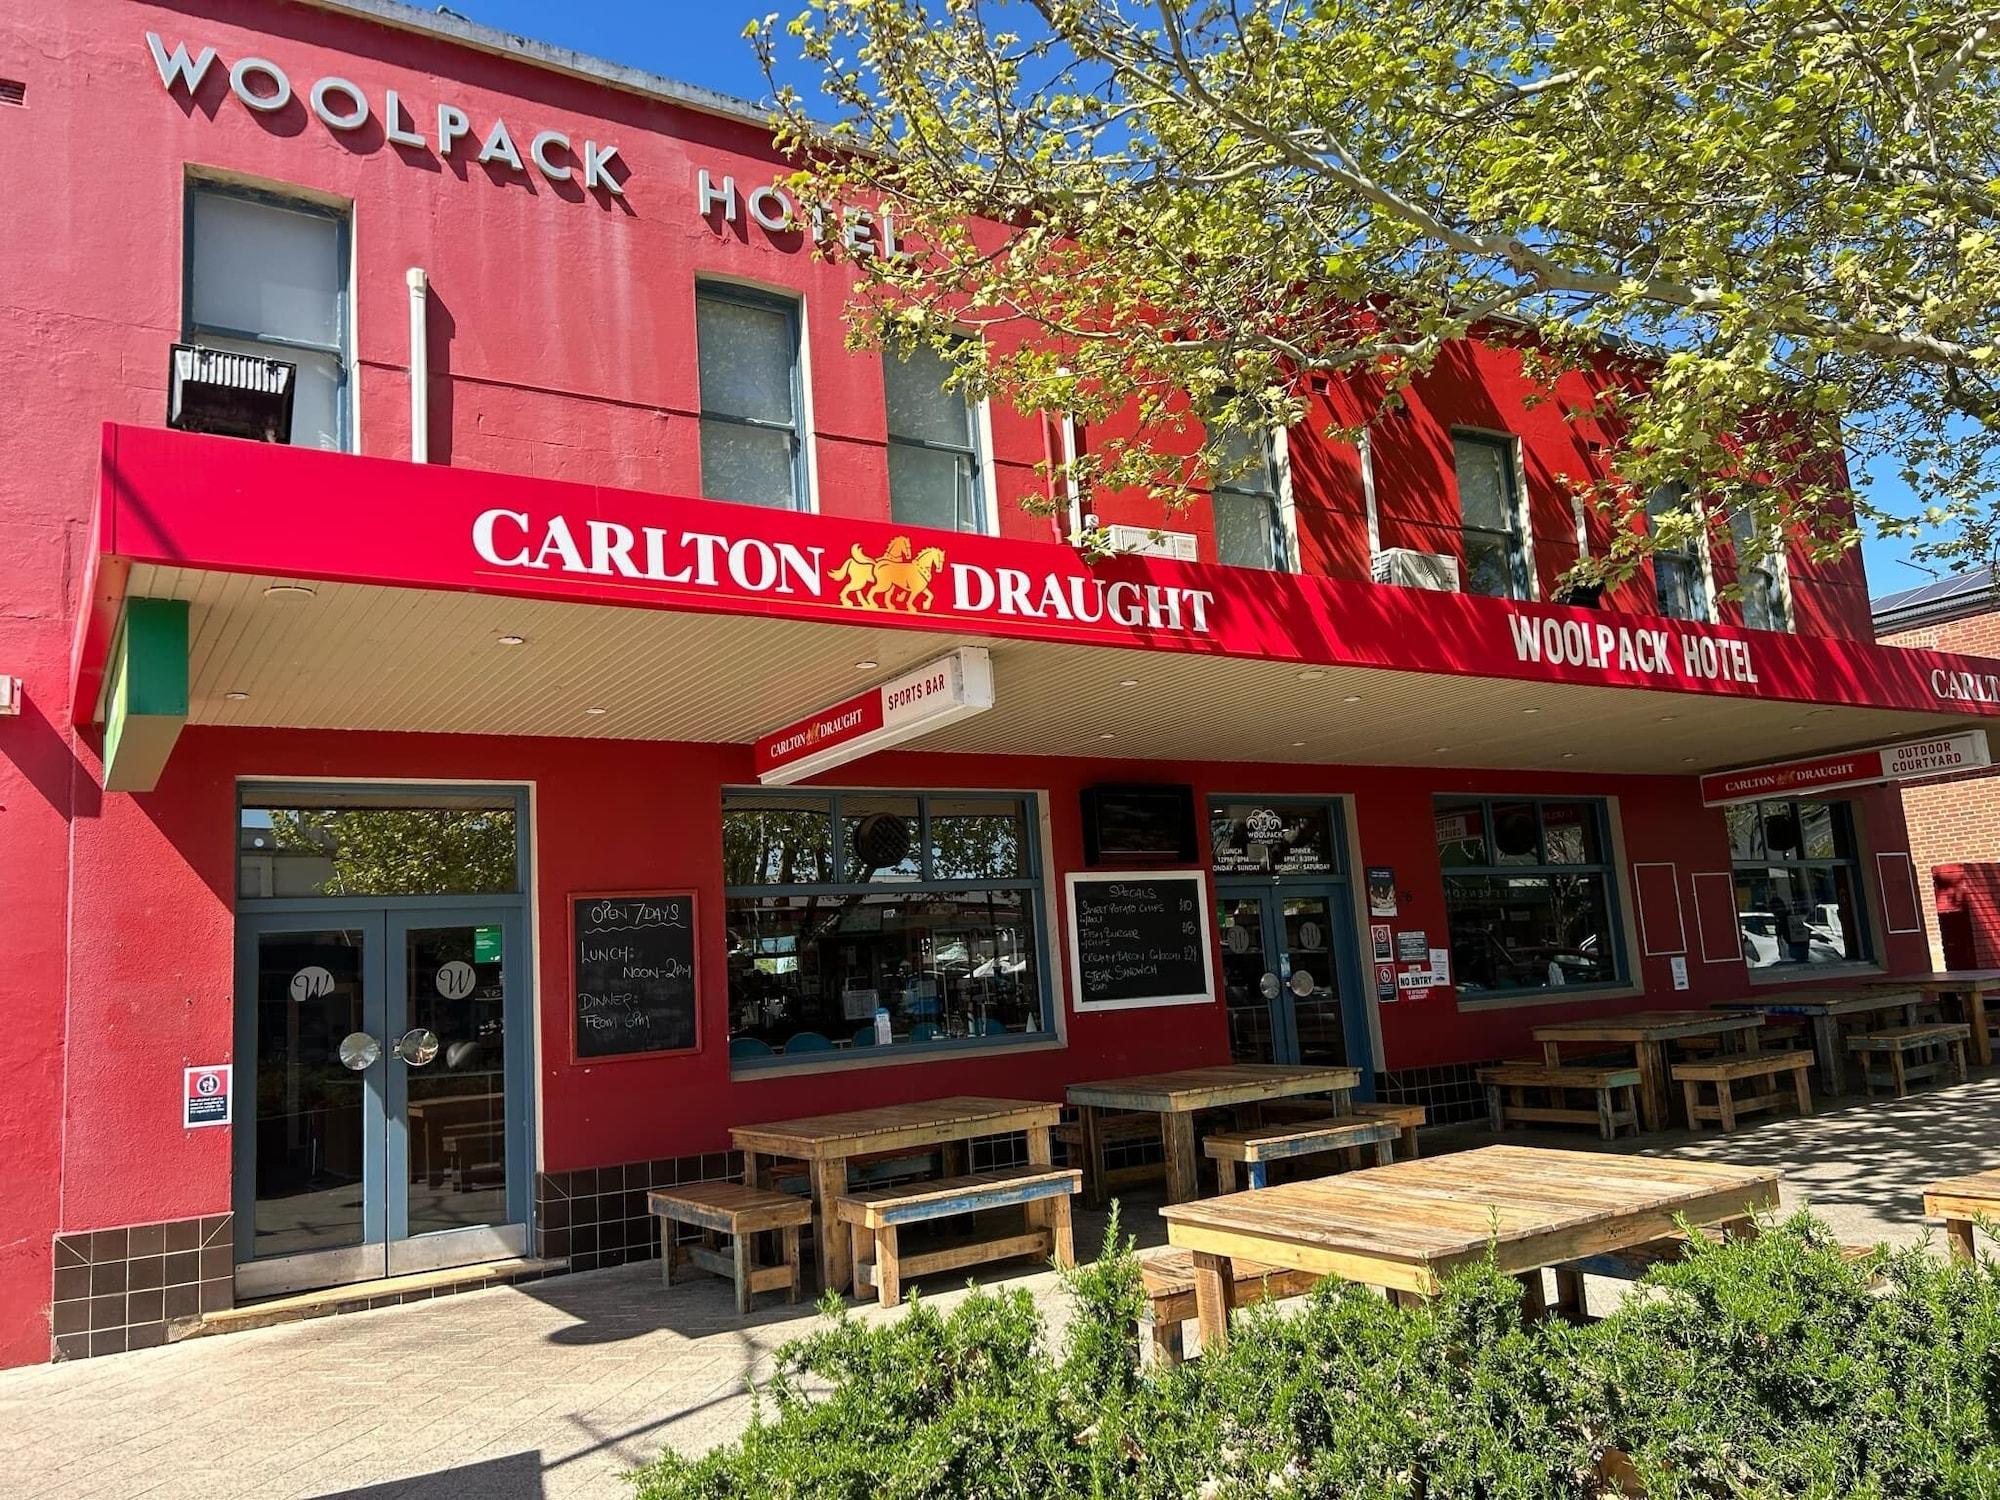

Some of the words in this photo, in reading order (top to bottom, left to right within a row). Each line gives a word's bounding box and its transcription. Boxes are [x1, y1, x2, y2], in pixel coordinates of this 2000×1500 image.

[146, 31, 624, 195] WOOLPACK
[698, 168, 913, 261] HOTEL
[471, 509, 825, 596] CARLTON
[951, 563, 1214, 632] DRAUGHT
[1508, 614, 1674, 675] WOOLPACK
[1682, 634, 1758, 684] HOTEL
[888, 683, 922, 711] SPORTS
[926, 674, 945, 696] BAR
[1931, 669, 2000, 702] CARLT
[770, 733, 807, 758] CARLTON
[820, 708, 863, 738] DRAUGHT
[1898, 742, 1951, 760] OUTDOOR
[1892, 753, 1962, 773] COURTYARD
[1725, 776, 1776, 793] CARLTON
[1797, 763, 1854, 781] DRAUGHT
[1248, 831, 1283, 839] WOOLPACK
[1303, 863, 1330, 871] SATURDAY
[591, 900, 627, 923] OPEN
[1108, 902, 1137, 915] POTATO
[581, 940, 634, 963] LUNCH:
[438, 968, 471, 994] W
[1085, 968, 1114, 982] STEAK
[1401, 977, 1409, 986] NO
[1411, 975, 1432, 986] ENTRY
[578, 992, 638, 1011] DINNER:
[580, 1013, 617, 1029] FROM
[625, 1011, 650, 1029] 6PM
